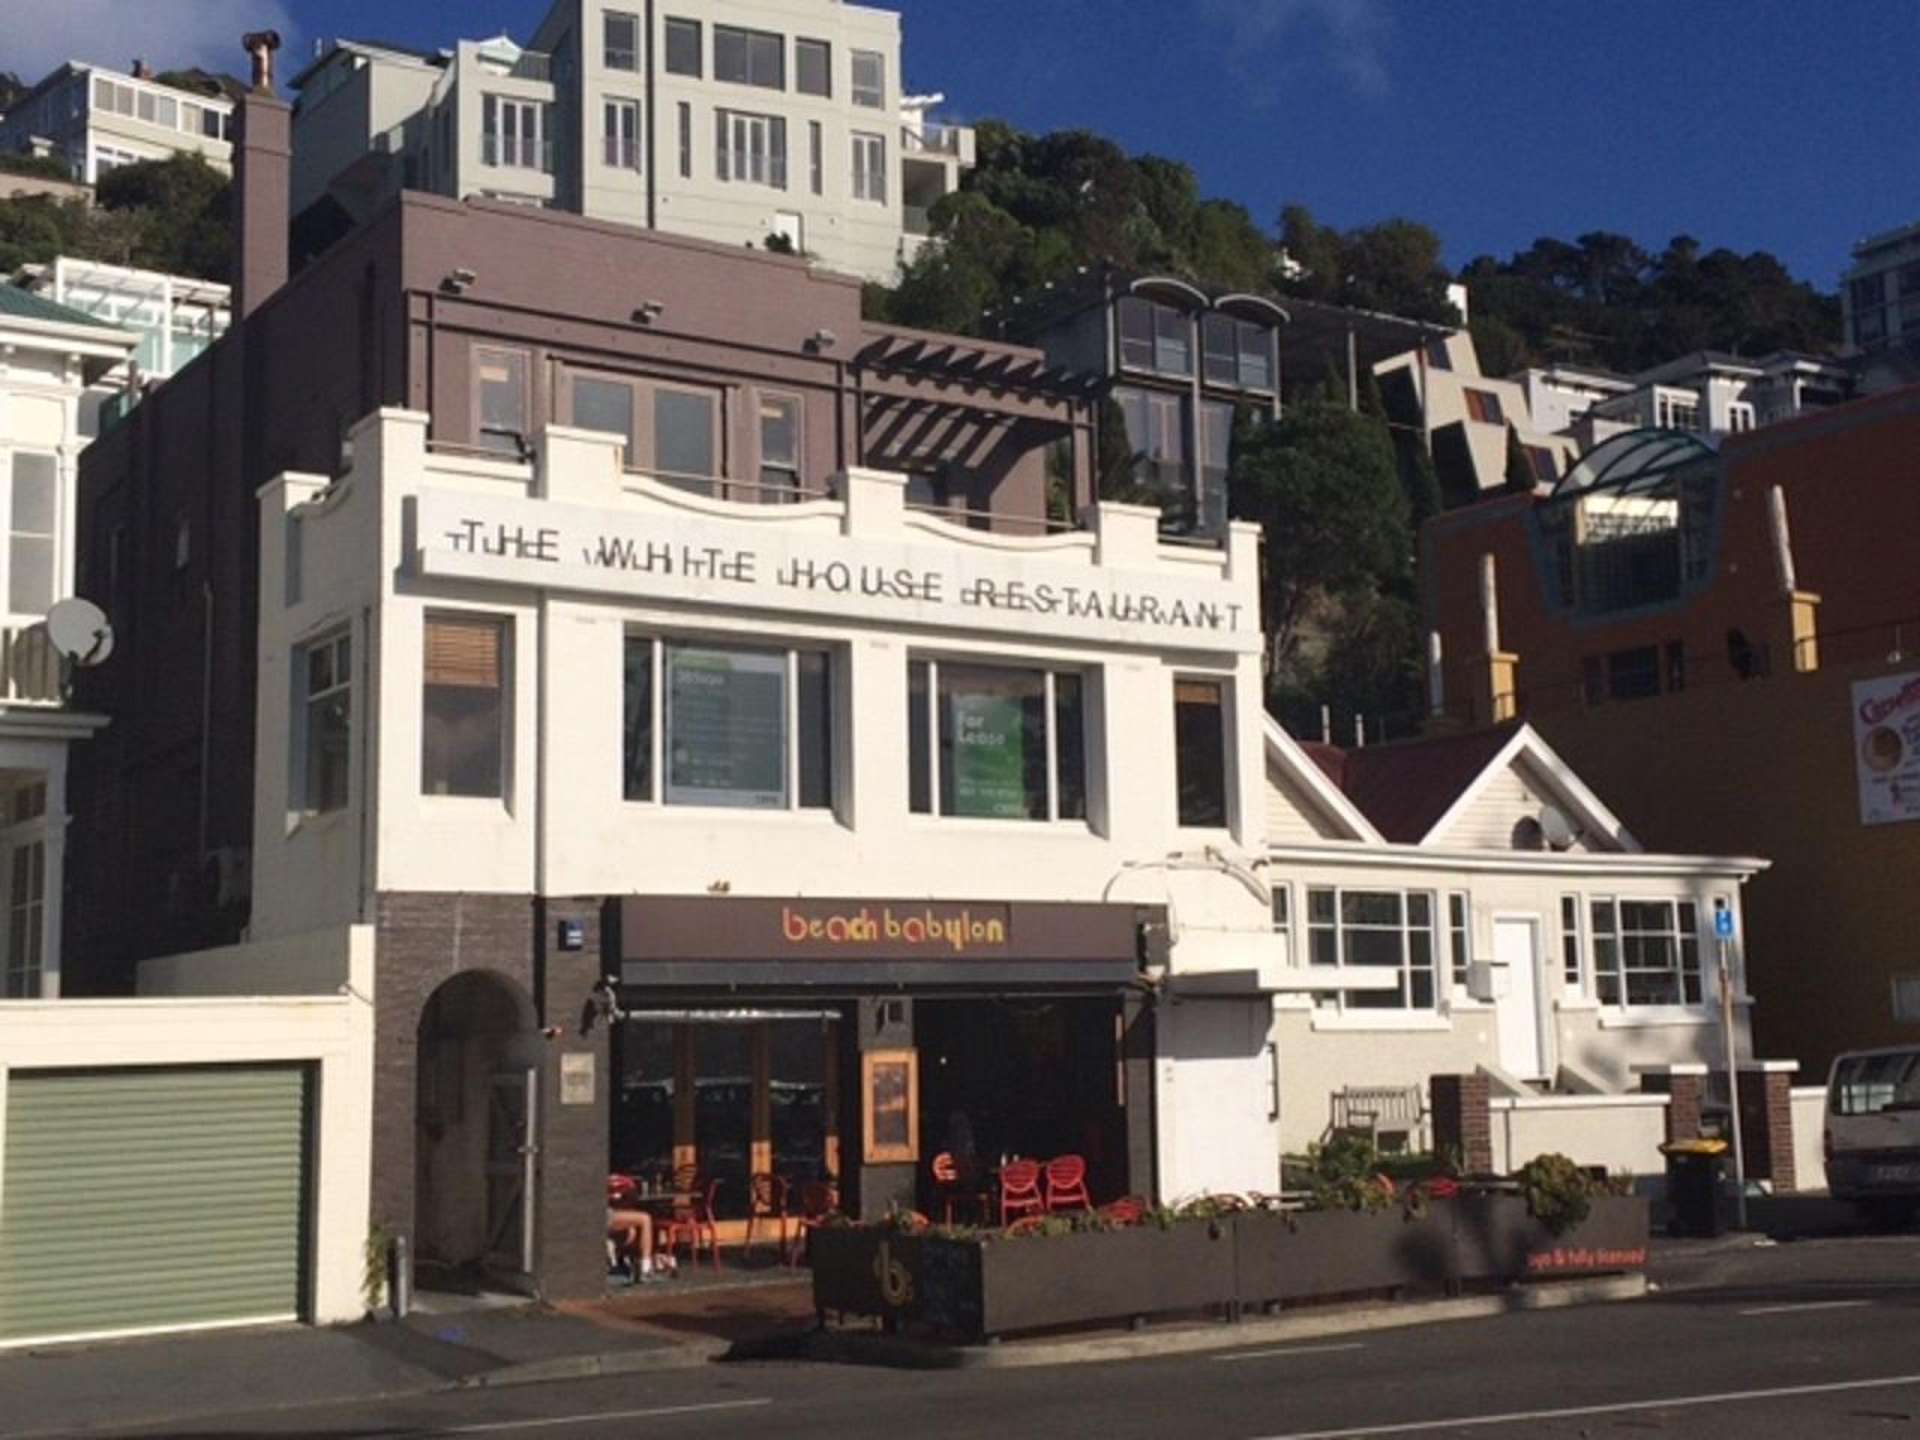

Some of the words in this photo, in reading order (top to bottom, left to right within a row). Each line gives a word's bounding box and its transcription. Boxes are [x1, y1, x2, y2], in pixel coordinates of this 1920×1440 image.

[453, 518, 560, 562] THE
[592, 536, 757, 584] WHITE
[784, 556, 942, 602] HOUSE
[965, 577, 1243, 632] RESTAURANT
[782, 907, 878, 942] beach
[884, 907, 1005, 952] babylon
